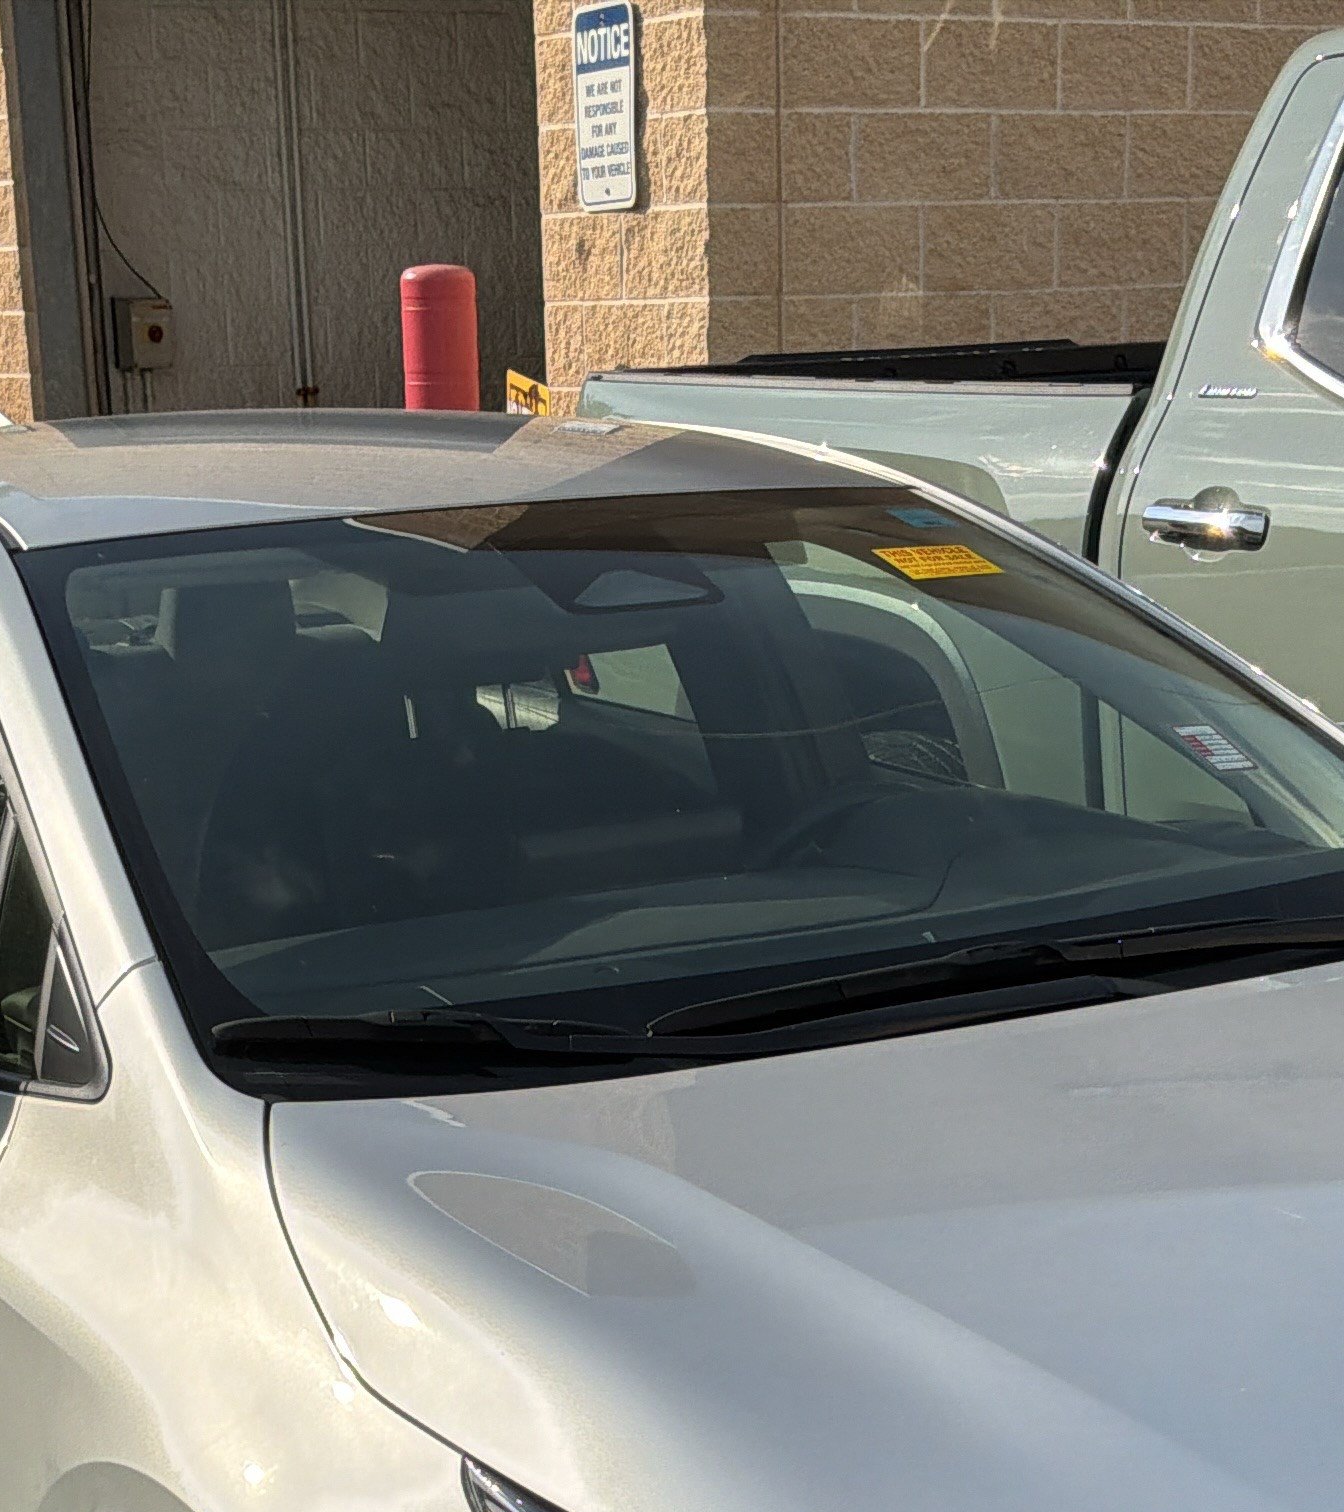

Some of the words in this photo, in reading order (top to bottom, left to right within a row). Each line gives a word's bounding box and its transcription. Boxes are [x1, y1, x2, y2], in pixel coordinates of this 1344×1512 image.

[577, 23, 629, 65] NOTICE
[597, 81, 608, 95] ARE
[610, 79, 622, 93] NOT
[584, 100, 624, 118] RESPONSIBLE
[592, 124, 603, 138] FOR
[604, 121, 617, 136] ANY
[581, 143, 605, 160] DAMAGE
